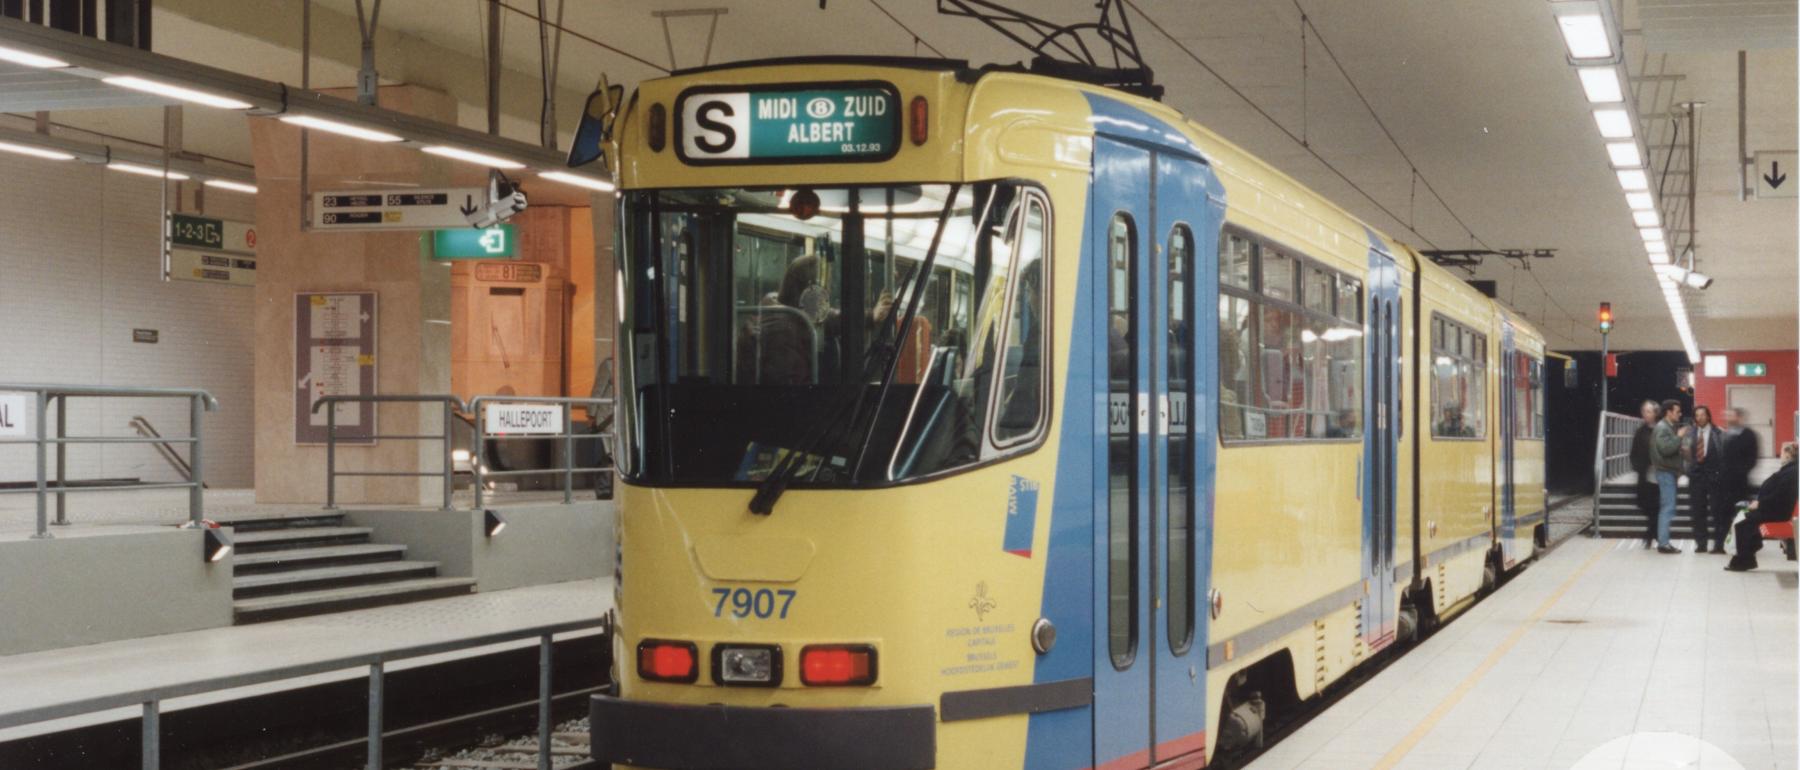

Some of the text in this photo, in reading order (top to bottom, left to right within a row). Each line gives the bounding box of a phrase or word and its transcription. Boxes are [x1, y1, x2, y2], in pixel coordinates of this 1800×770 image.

[758, 98, 797, 119] MIDI
[844, 95, 887, 116] ZUID
[694, 100, 737, 154] S
[787, 121, 856, 143] ALBERT
[841, 142, 881, 153] 03.12.93
[323, 197, 337, 208] 23
[388, 195, 402, 206] 55
[324, 213, 337, 224] 90
[175, 222, 204, 240] 1-2-3
[499, 410, 552, 428] HALLEPOORT
[712, 587, 797, 619] 7907
